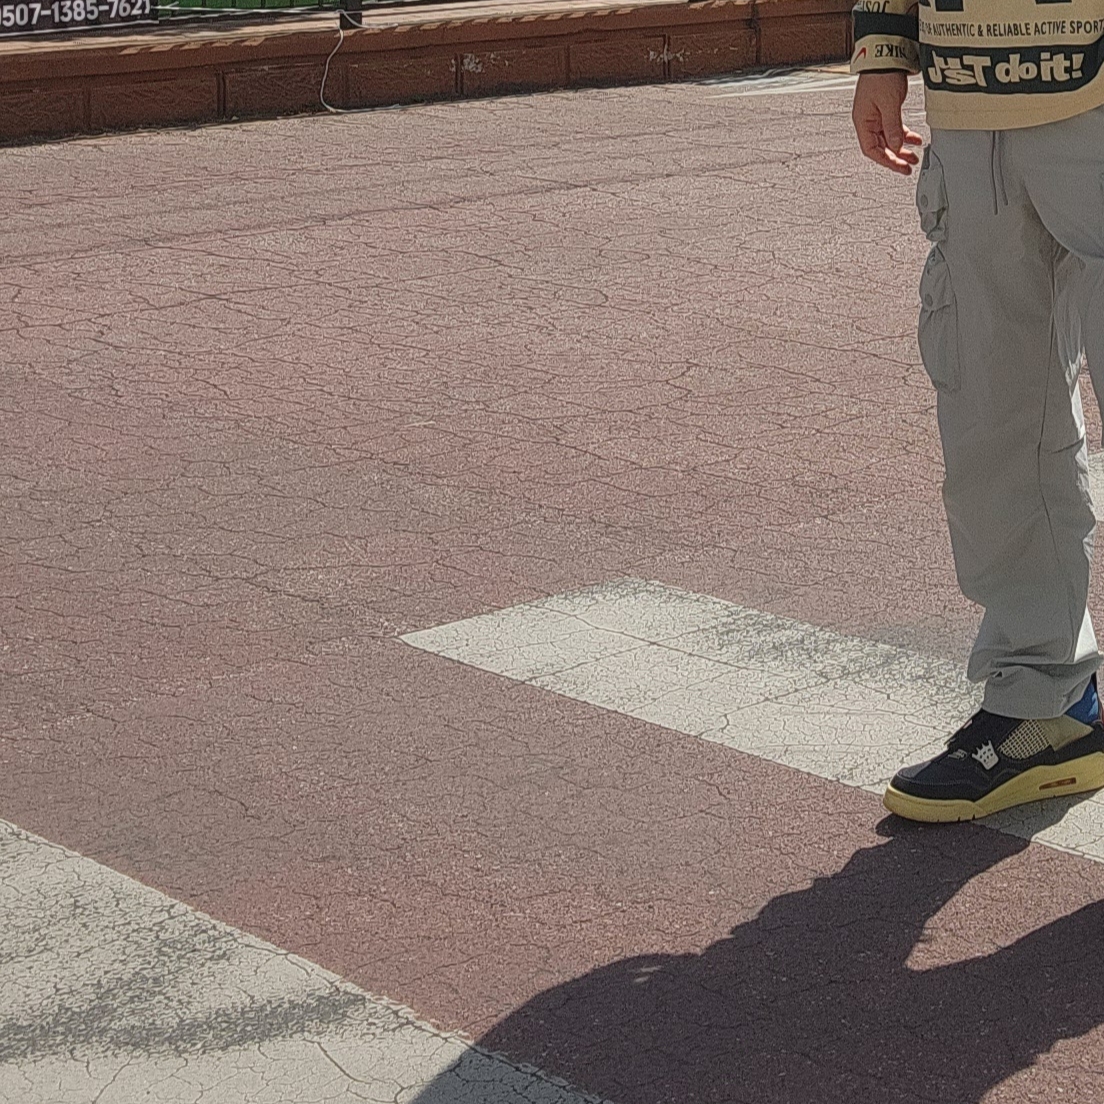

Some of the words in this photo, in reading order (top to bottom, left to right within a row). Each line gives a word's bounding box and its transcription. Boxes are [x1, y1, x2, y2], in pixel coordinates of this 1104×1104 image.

[933, 22, 975, 37] AUTHENTIC
[977, 24, 984, 37] &
[987, 23, 1031, 37] RELIABLE
[1034, 20, 1066, 35] ACTIVE
